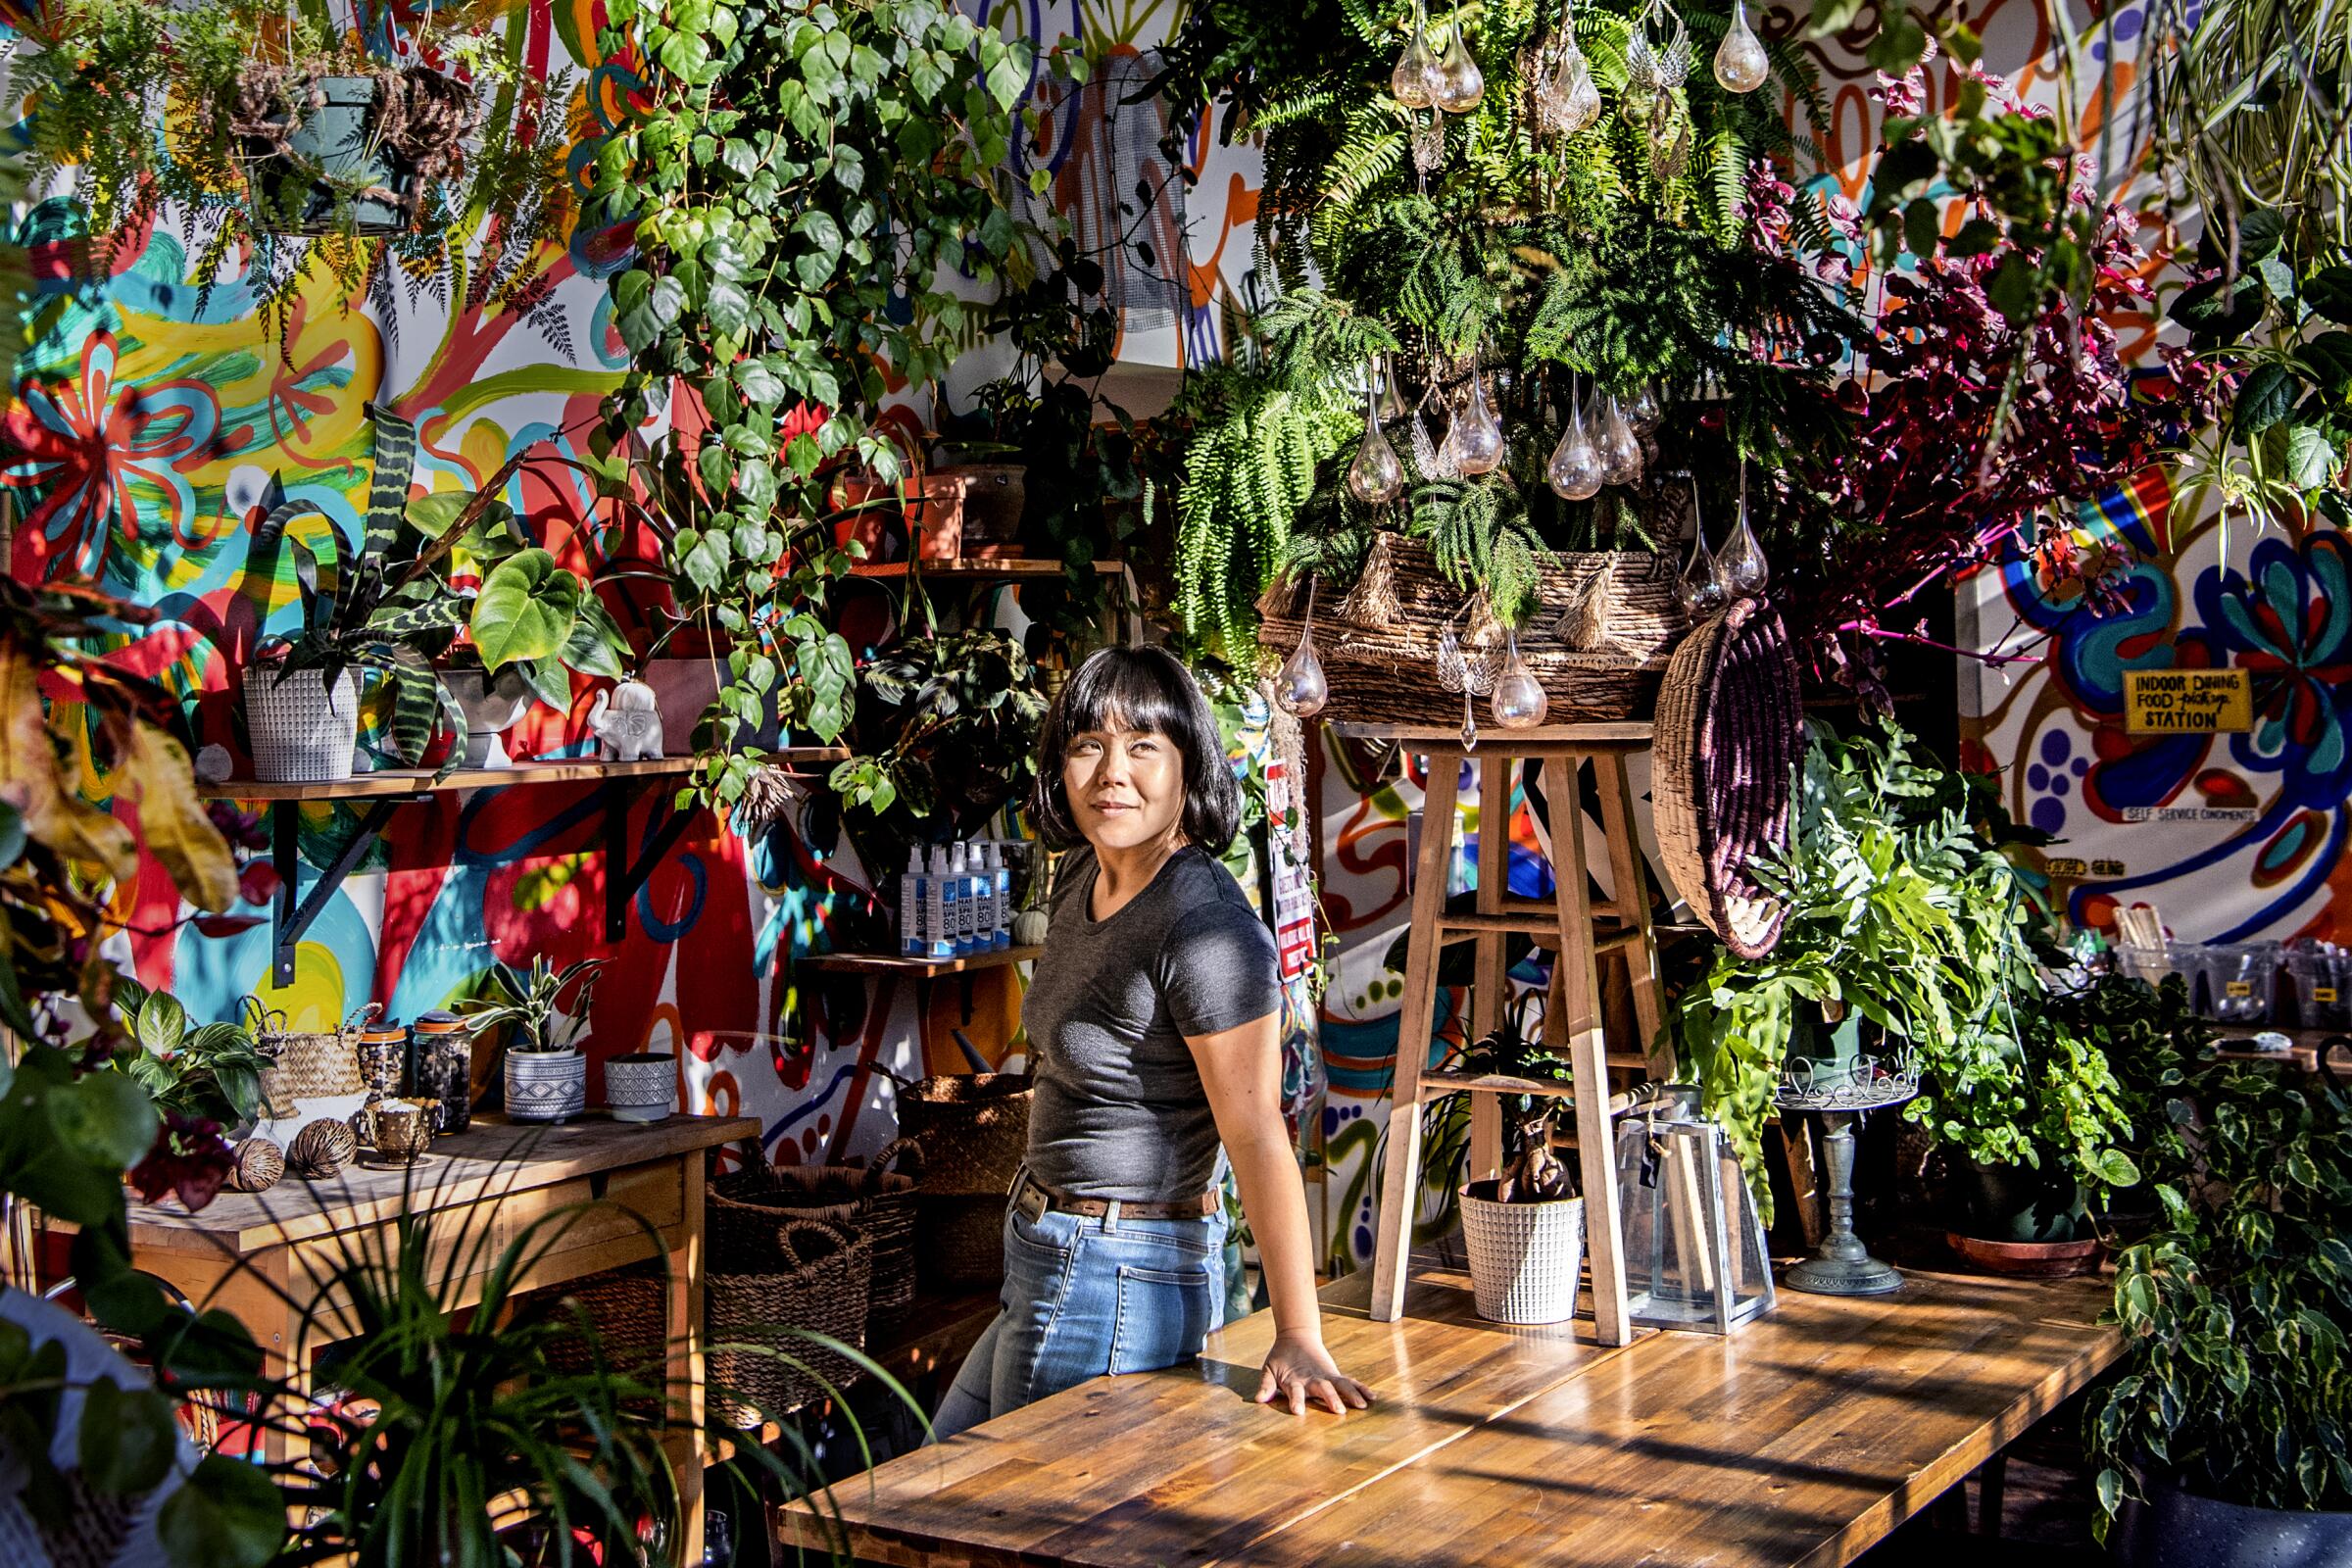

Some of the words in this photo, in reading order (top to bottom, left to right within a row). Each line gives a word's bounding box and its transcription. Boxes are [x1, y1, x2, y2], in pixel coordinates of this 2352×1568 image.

[2135, 677, 2185, 691] INDOOR
[2193, 675, 2239, 690] DINING
[2137, 693, 2174, 709] FOOD
[2145, 711, 2217, 728] STATION
[2128, 807, 2151, 820] SELF
[2158, 808, 2197, 821] SERVICE
